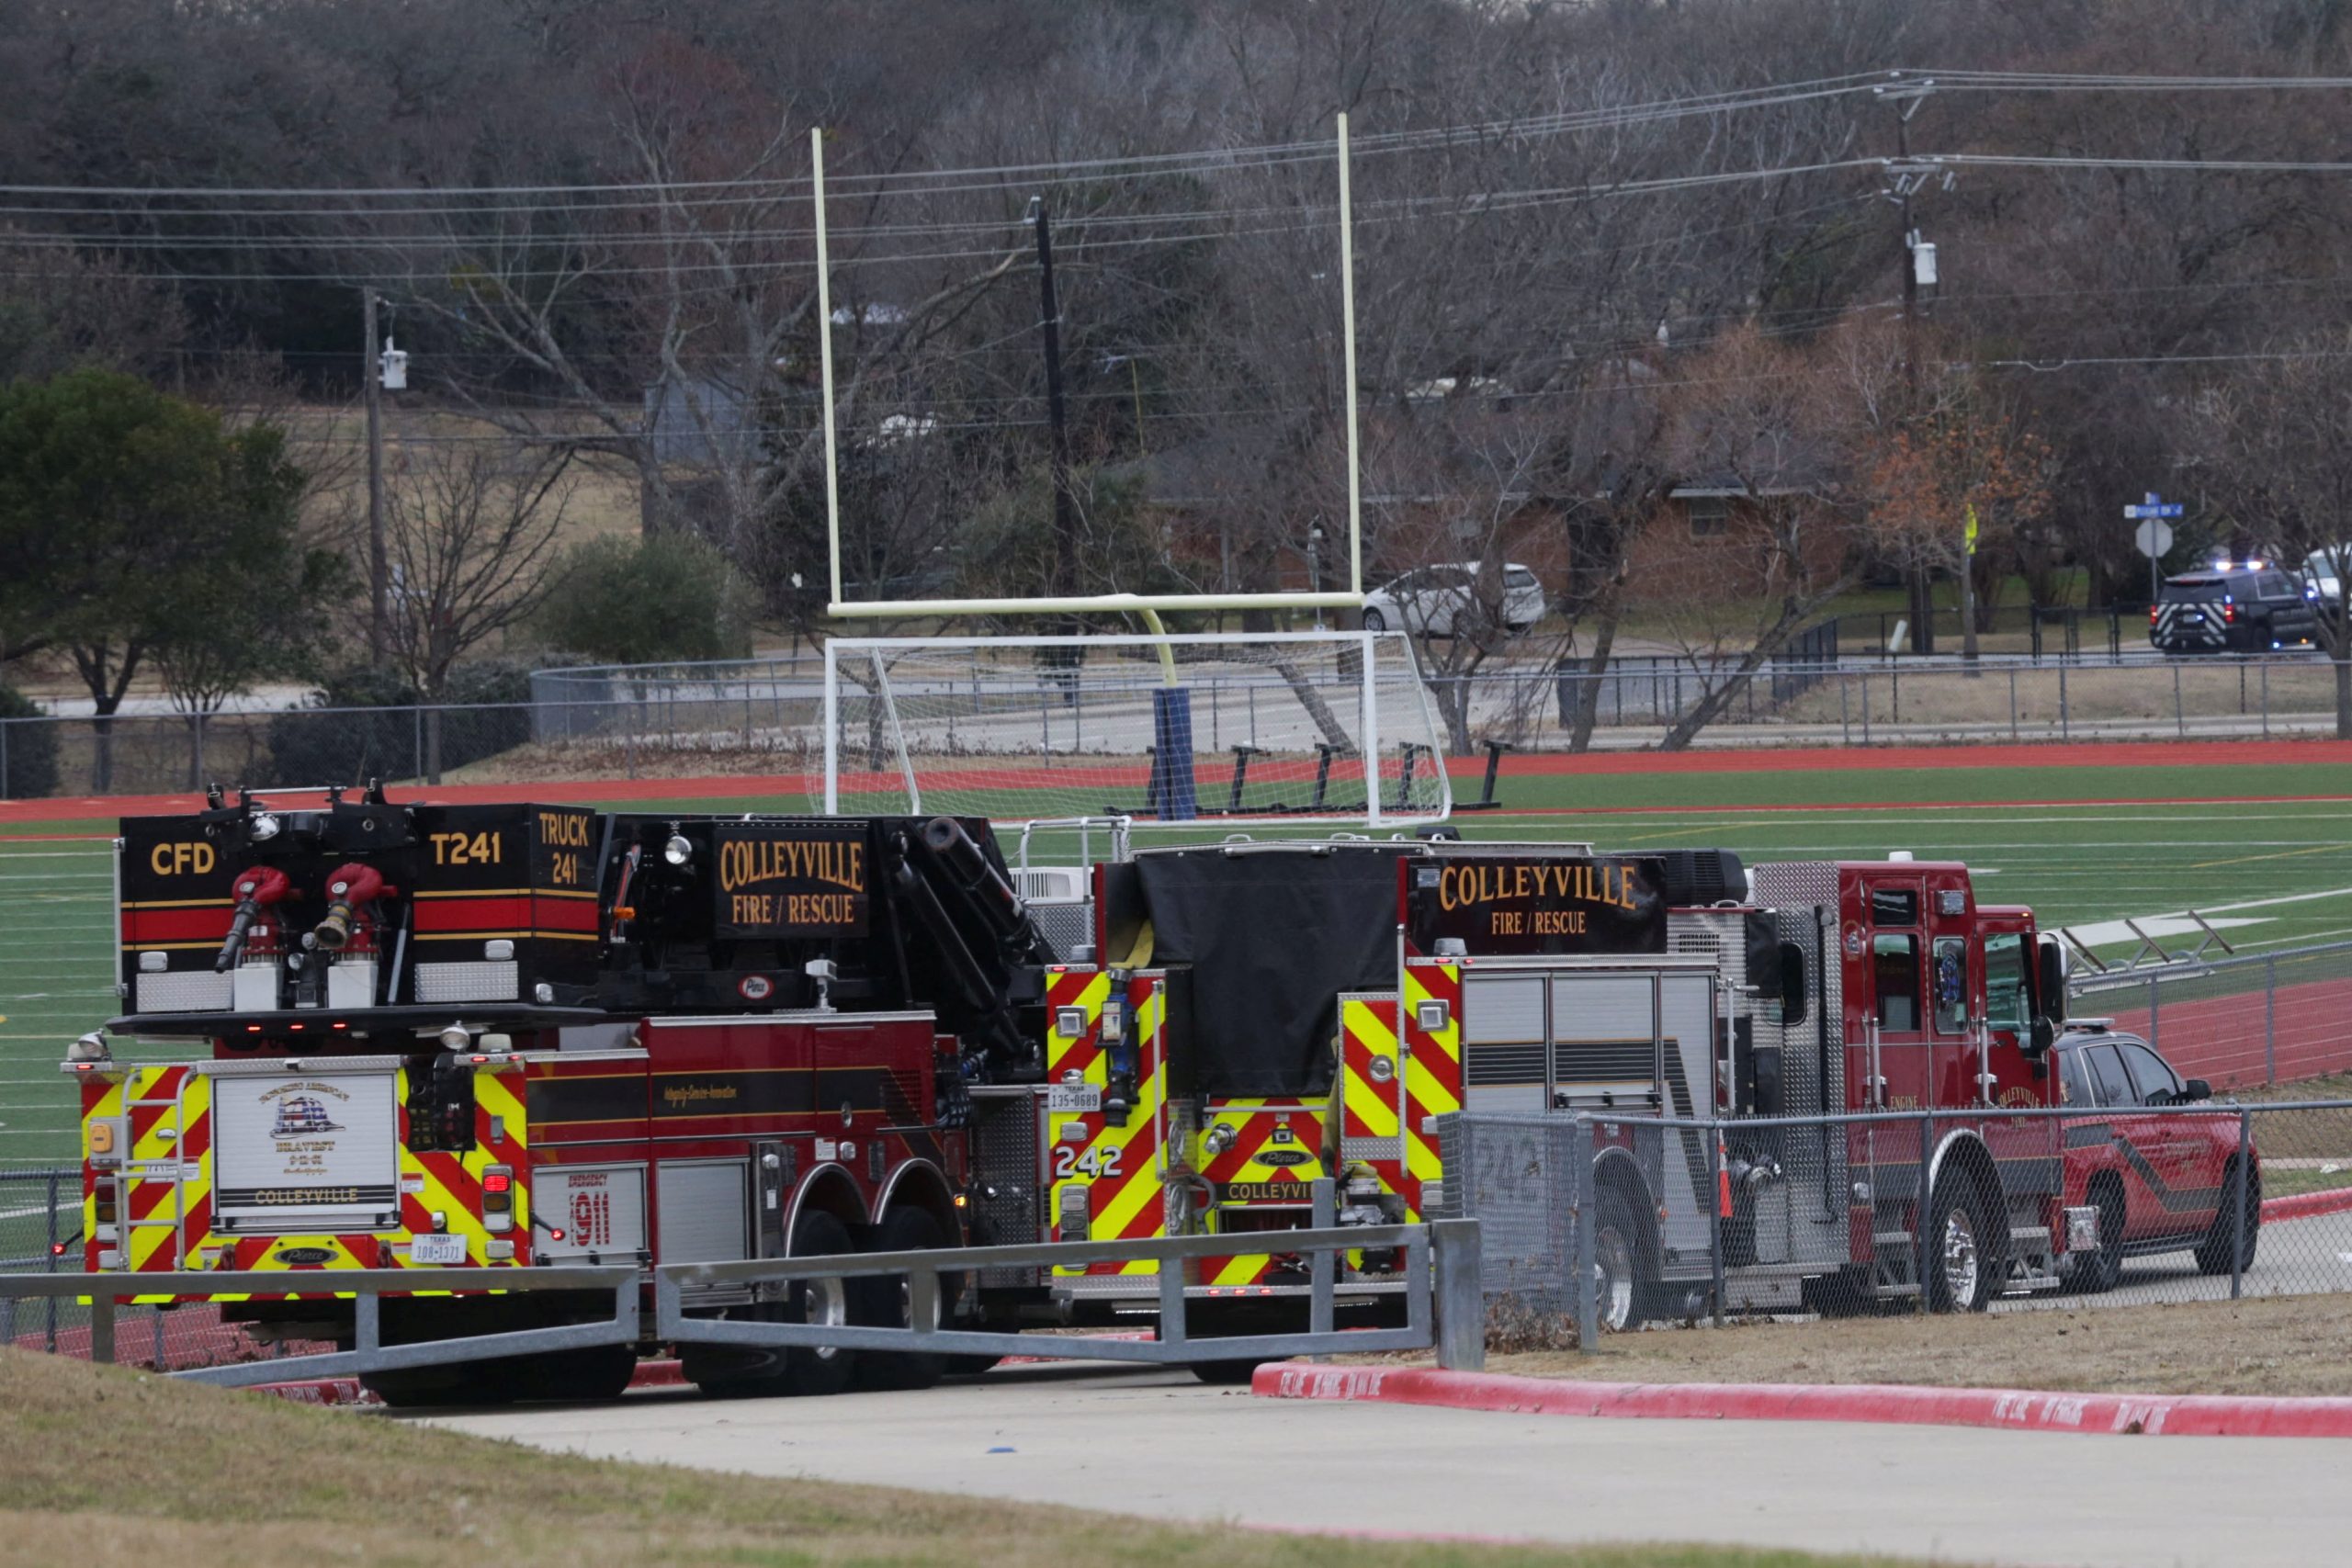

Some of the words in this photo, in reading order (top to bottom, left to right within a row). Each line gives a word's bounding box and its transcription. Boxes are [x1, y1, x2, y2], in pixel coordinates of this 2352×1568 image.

[539, 813, 588, 846] TRUCK
[152, 842, 214, 874] CFD
[430, 832, 501, 864] T241
[553, 852, 577, 884] 241
[720, 840, 863, 892] COLLEYVILLE
[1440, 866, 1636, 911] COLLEYVILLE
[732, 895, 772, 923] FIRE
[788, 894, 854, 923] RESCUE
[1492, 911, 1522, 935] FIRE
[1535, 911, 1586, 934] RESCUE
[1055, 1145, 1123, 1179] 242
[1265, 1151, 1301, 1165] Pierce
[255, 1189, 358, 1205] COLLEYVILLE
[1229, 1182, 1314, 1200] COLLEYVI
[575, 1191, 610, 1247] 911
[287, 1248, 323, 1265] Pierce
[416, 1245, 460, 1260] 108-1371
